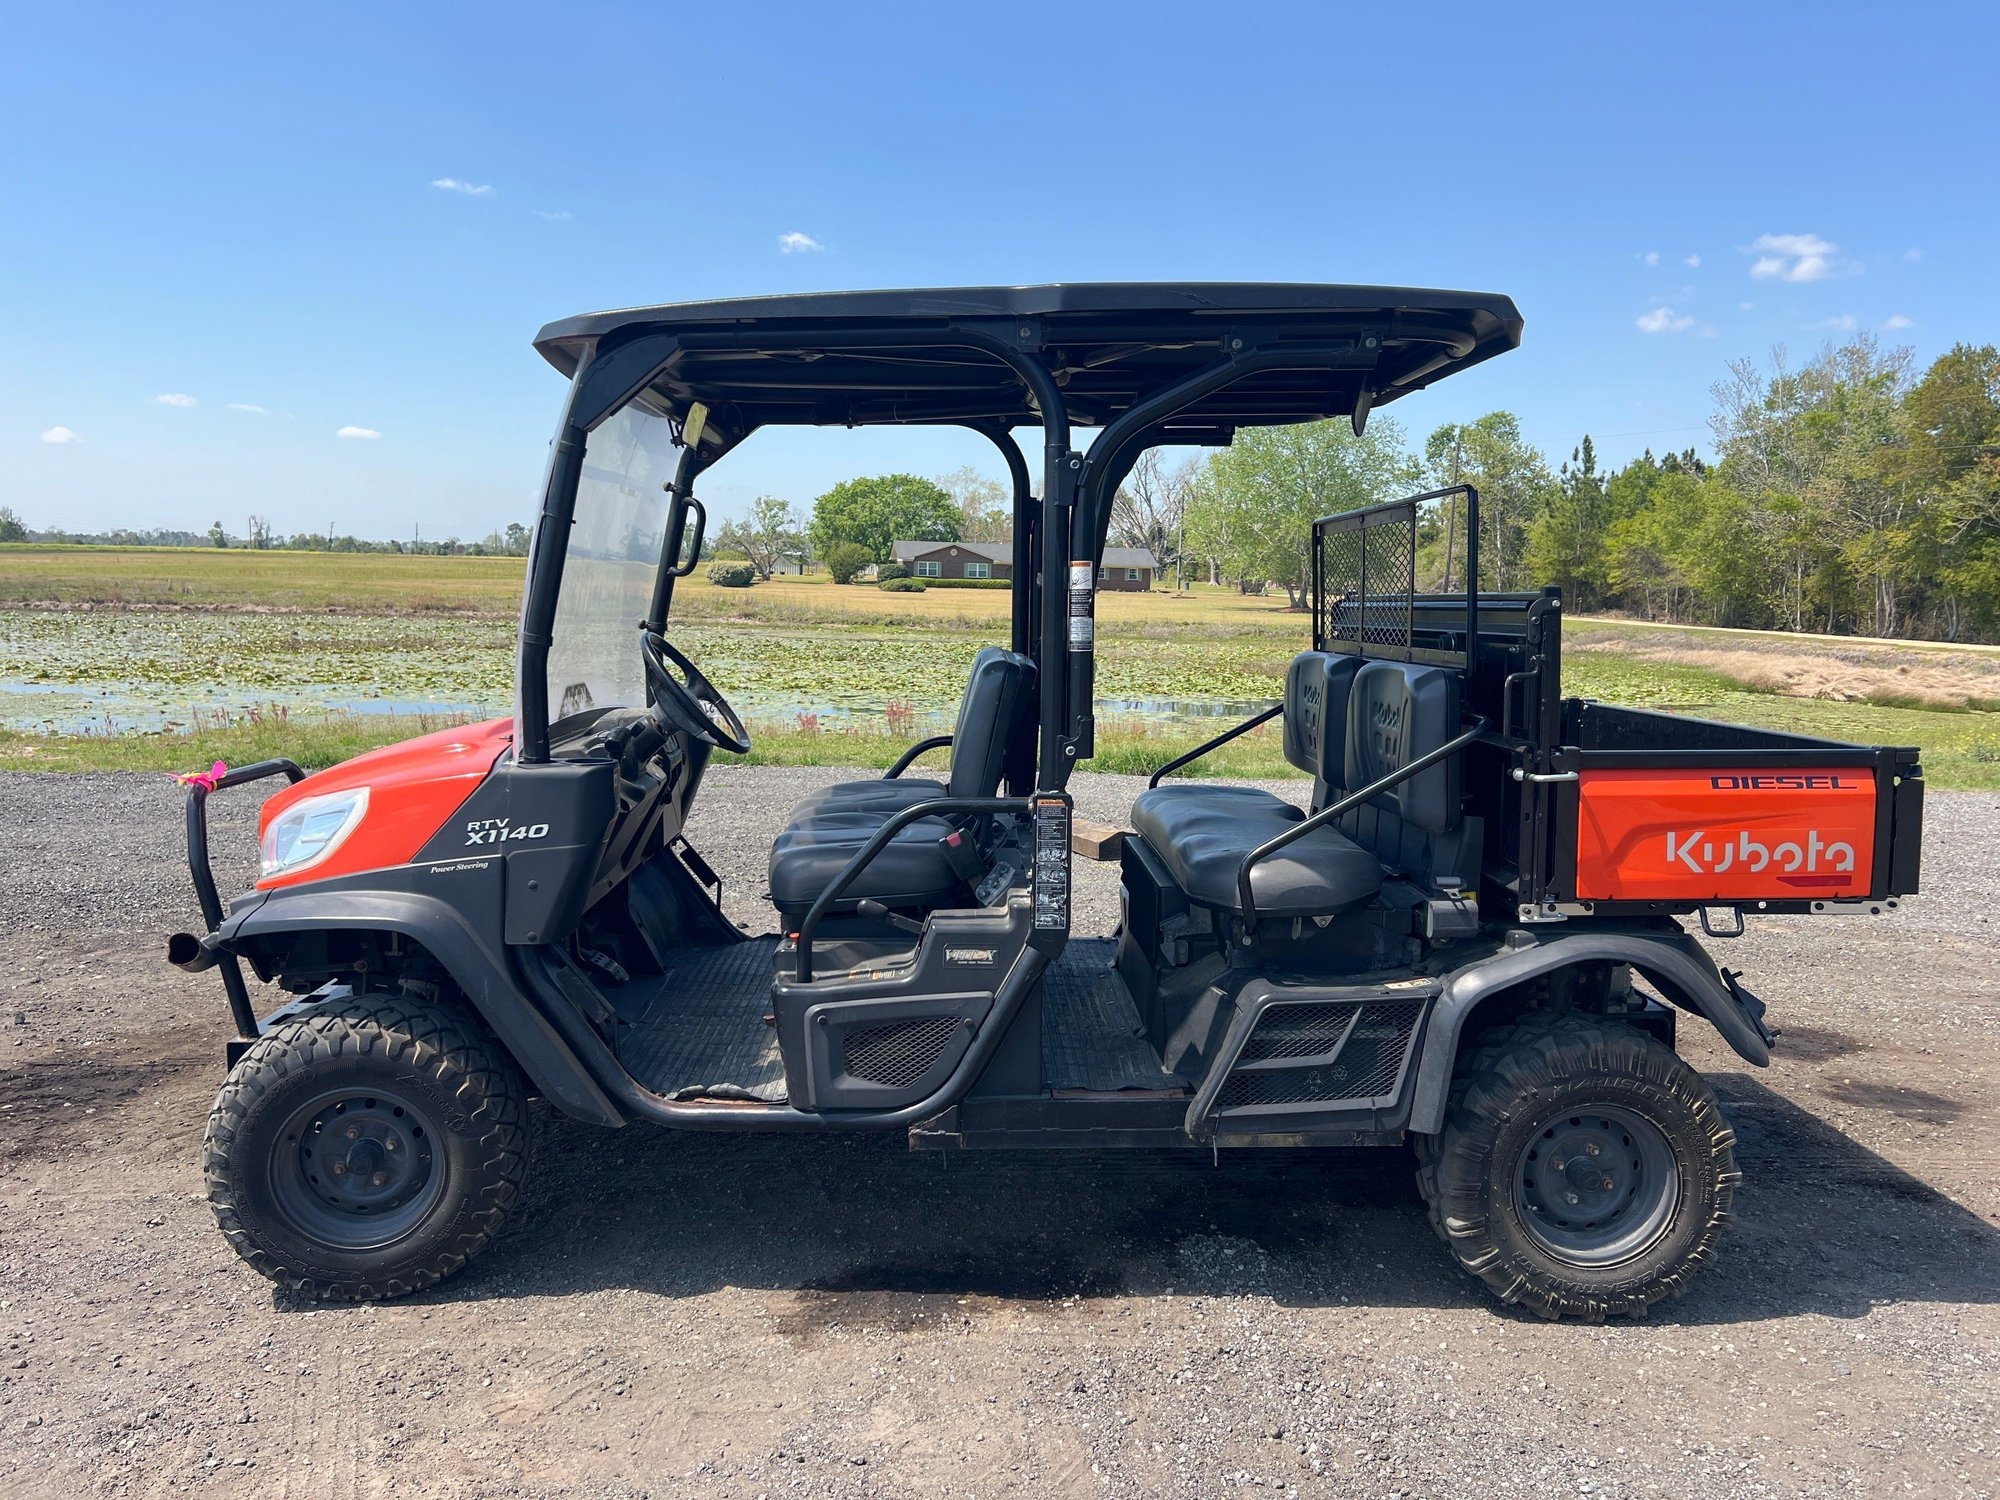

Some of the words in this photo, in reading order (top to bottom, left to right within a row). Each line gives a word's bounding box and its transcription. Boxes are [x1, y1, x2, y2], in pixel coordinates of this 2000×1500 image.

[1711, 776, 1857, 790] DIESEL
[465, 824, 549, 846] X1140
[467, 818, 510, 831] RTV
[1666, 831, 1855, 873] Kubota
[430, 866, 455, 874] Power
[456, 861, 489, 871] Steering
[1546, 1273, 1600, 1294] TRAIL
[1602, 1261, 1667, 1294] VERSA
